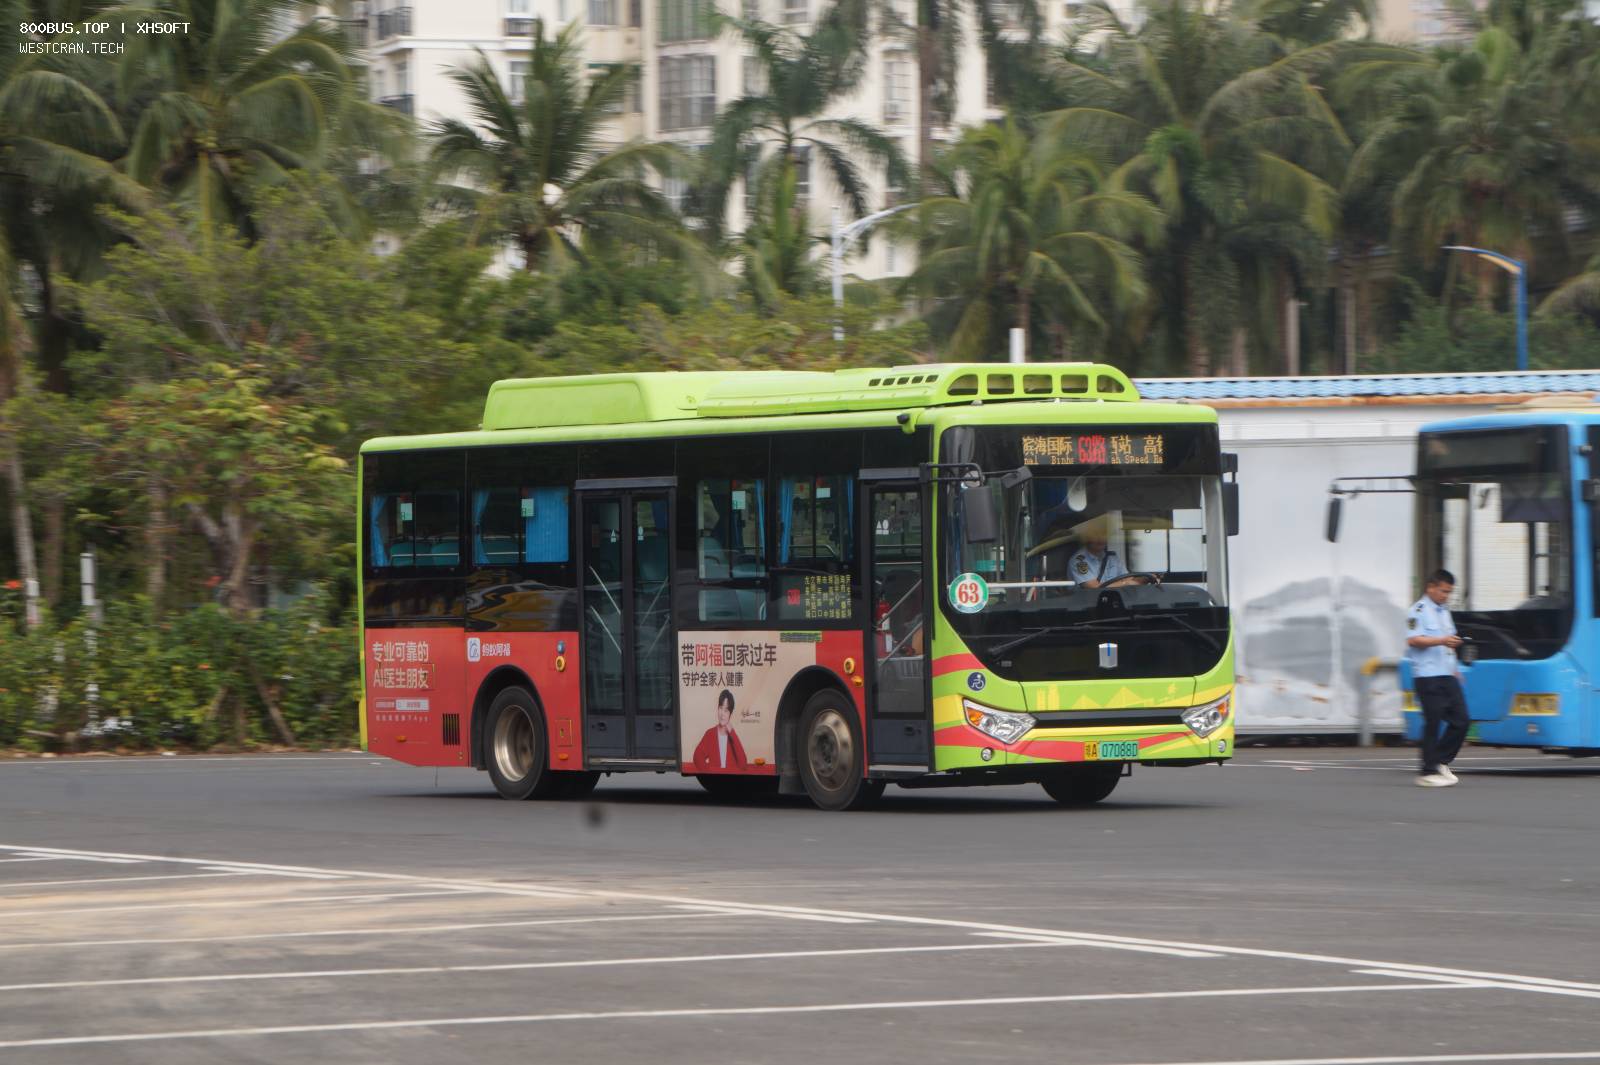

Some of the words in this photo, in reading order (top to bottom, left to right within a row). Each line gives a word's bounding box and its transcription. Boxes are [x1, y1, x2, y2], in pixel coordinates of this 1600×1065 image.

[958, 582, 979, 604] 63
[372, 640, 429, 662] 专业可靠的
[681, 643, 777, 667] 带阿福回家过年
[373, 668, 429, 689] AI医生朋友
[682, 671, 744, 687] 守护全家人健康
